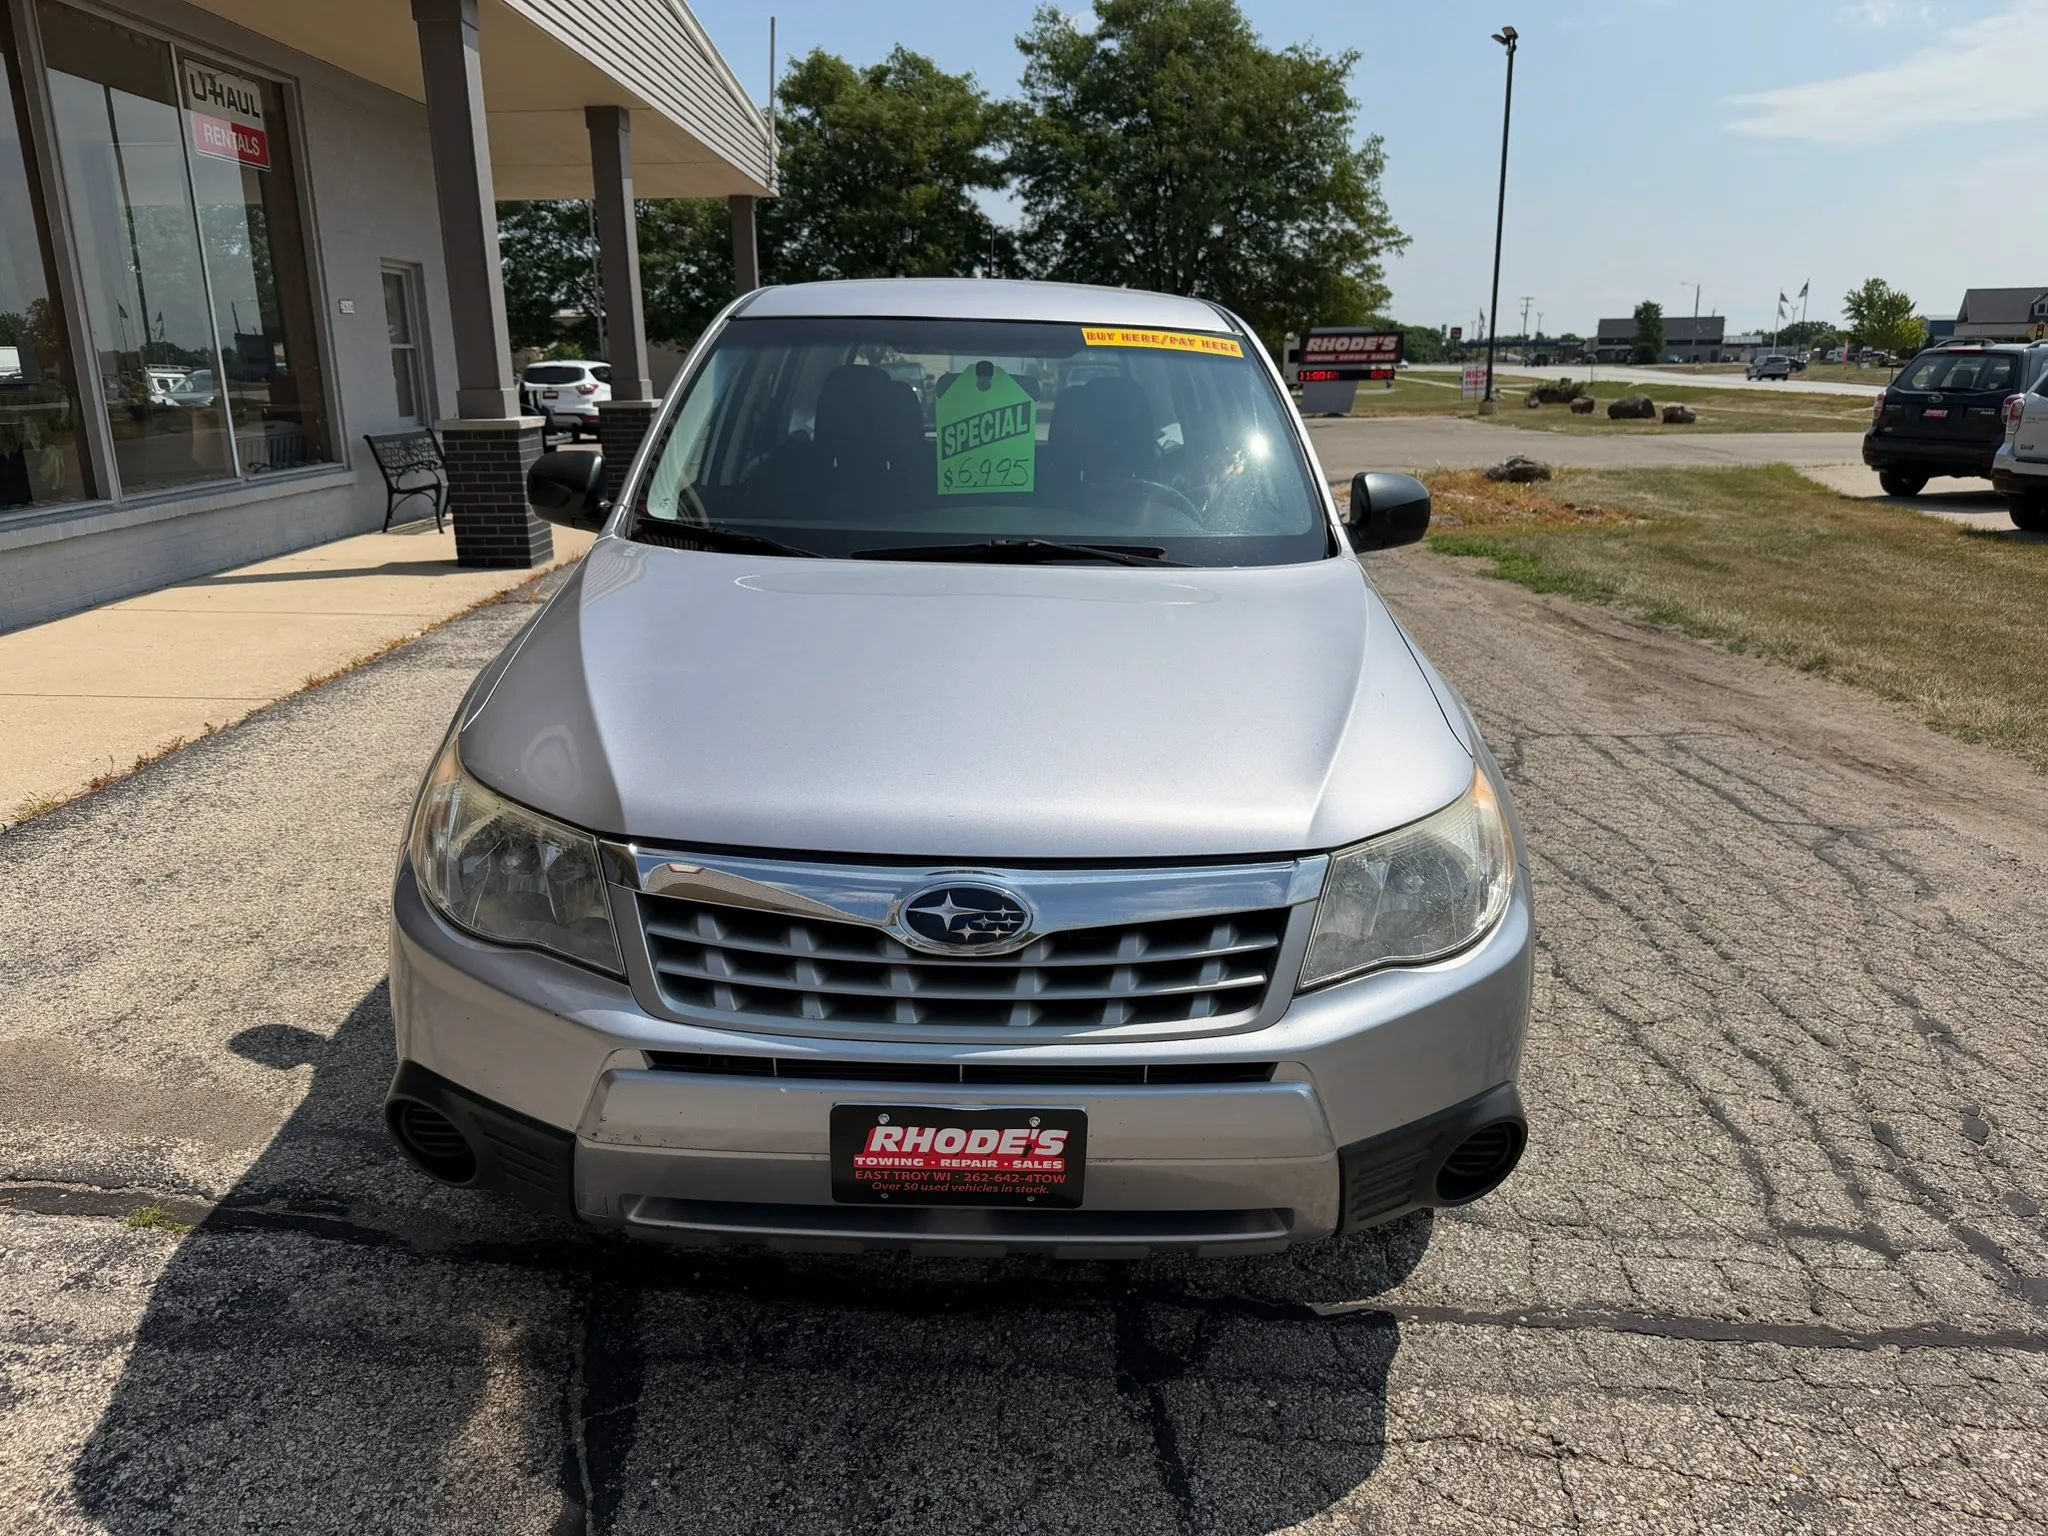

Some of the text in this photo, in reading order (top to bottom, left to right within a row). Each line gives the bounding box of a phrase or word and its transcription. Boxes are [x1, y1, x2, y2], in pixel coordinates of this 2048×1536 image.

[189, 71, 261, 119] U-HAUL
[203, 123, 260, 156] RENTALS
[1086, 332, 1238, 353] BUY HERE/PAY HERE
[1306, 336, 1399, 352] RHODE'S
[944, 405, 1028, 457] SPECIAL
[868, 1126, 1069, 1156] RHODE'S
[855, 1157, 1063, 1170] TOWING REPAIR SALES
[855, 1170, 1067, 1184] EAST TROY WI 262-642-4TOW
[871, 1182, 1050, 1194] Over 50 used vehicles in stock.
